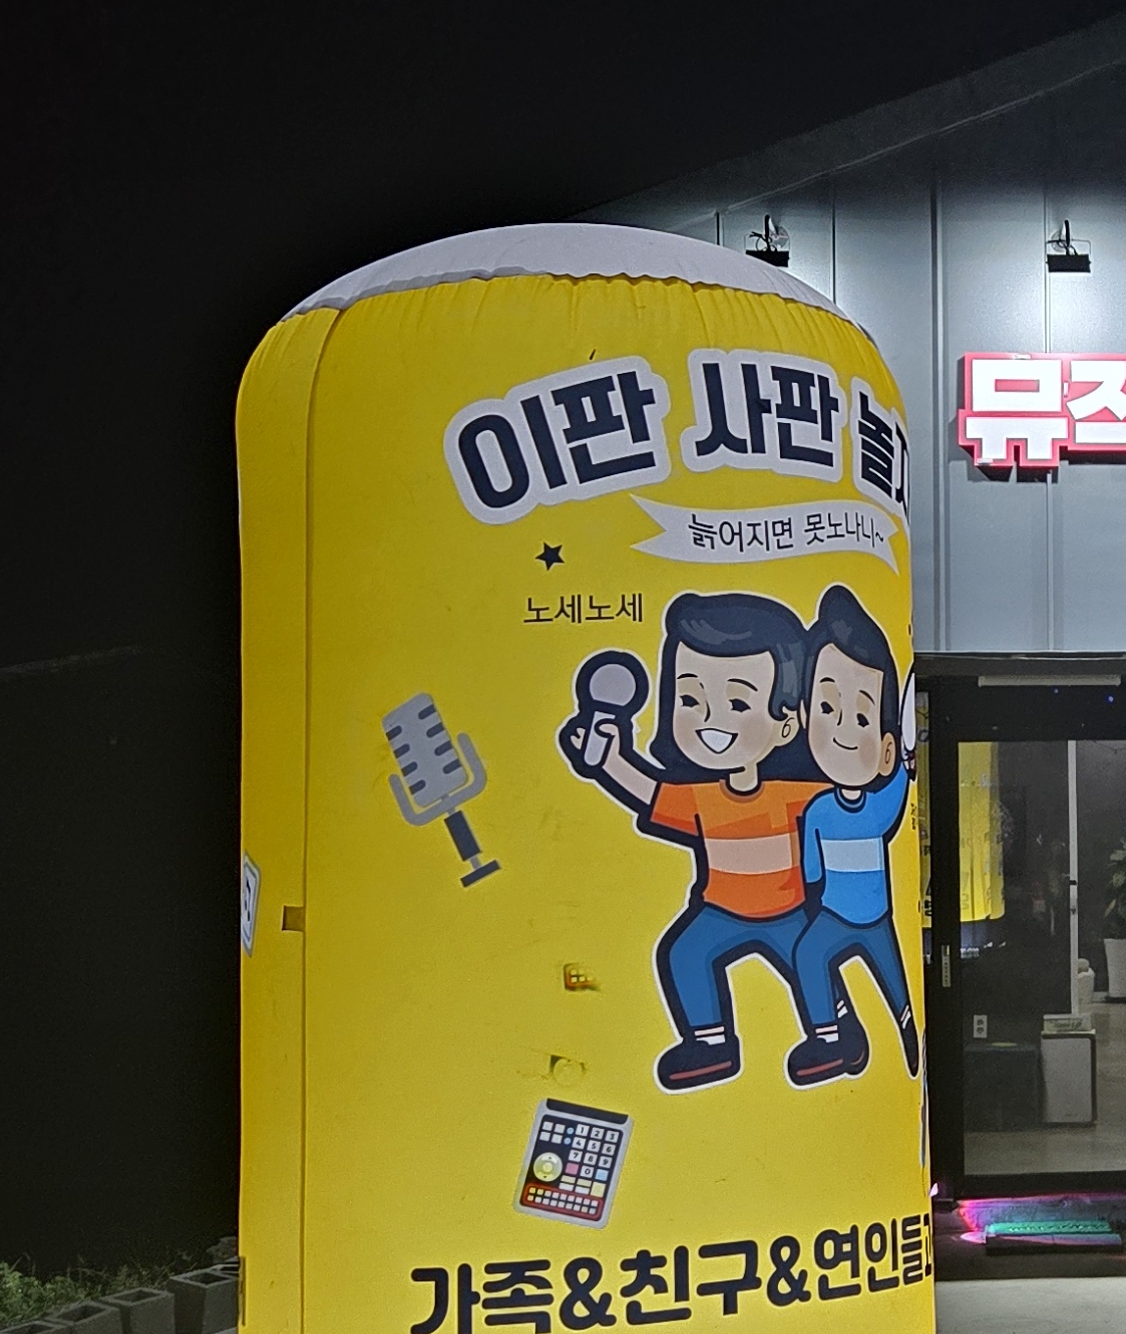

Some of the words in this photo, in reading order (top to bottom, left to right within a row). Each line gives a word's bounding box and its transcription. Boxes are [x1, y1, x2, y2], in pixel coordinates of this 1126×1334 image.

[456, 369, 657, 510] 이판
[694, 362, 840, 467] 사판
[688, 513, 794, 552] 늙어지면
[522, 593, 645, 625] 노세노세
